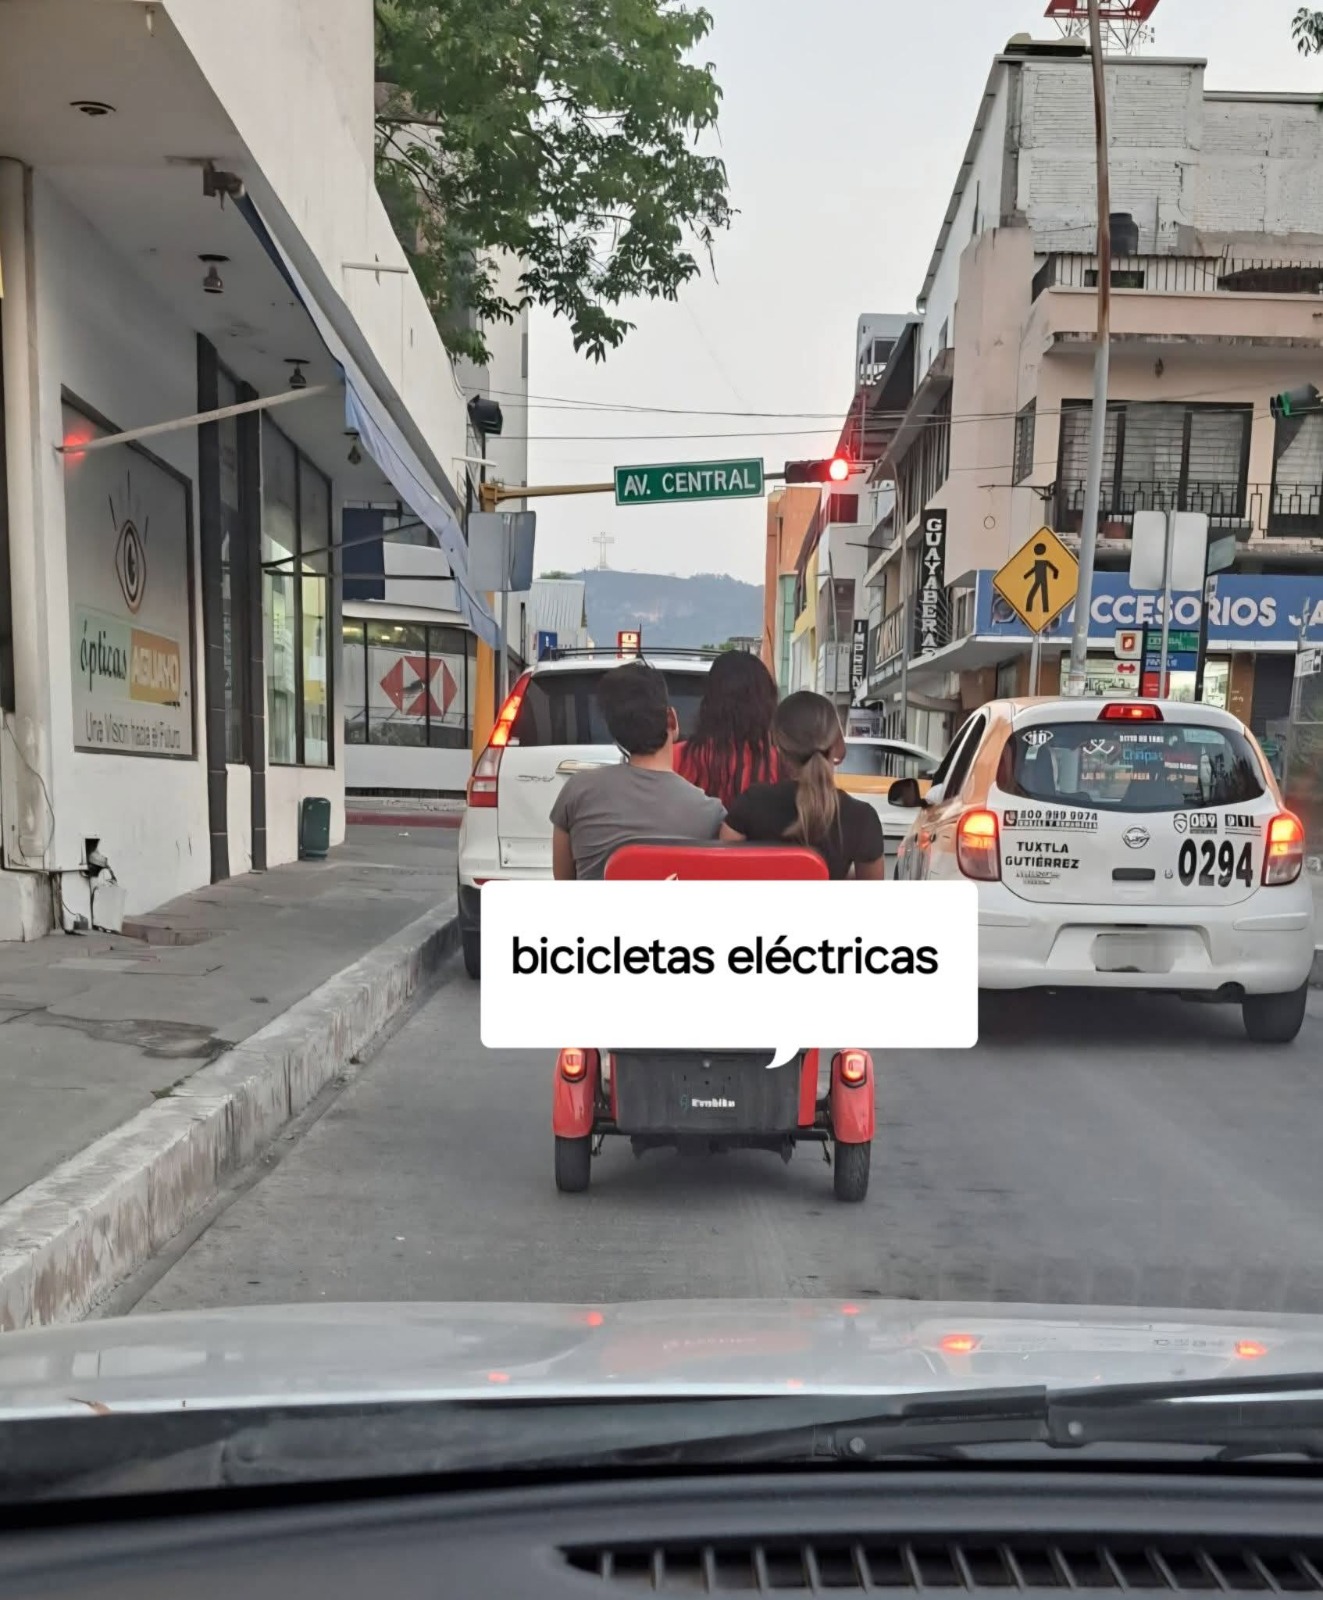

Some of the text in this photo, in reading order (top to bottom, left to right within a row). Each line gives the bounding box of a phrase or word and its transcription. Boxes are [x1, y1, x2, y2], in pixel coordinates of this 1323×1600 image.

[624, 468, 756, 496] AV. CENTRAL
[1016, 841, 1069, 854] TUXTLA
[1178, 838, 1253, 888] 0294
